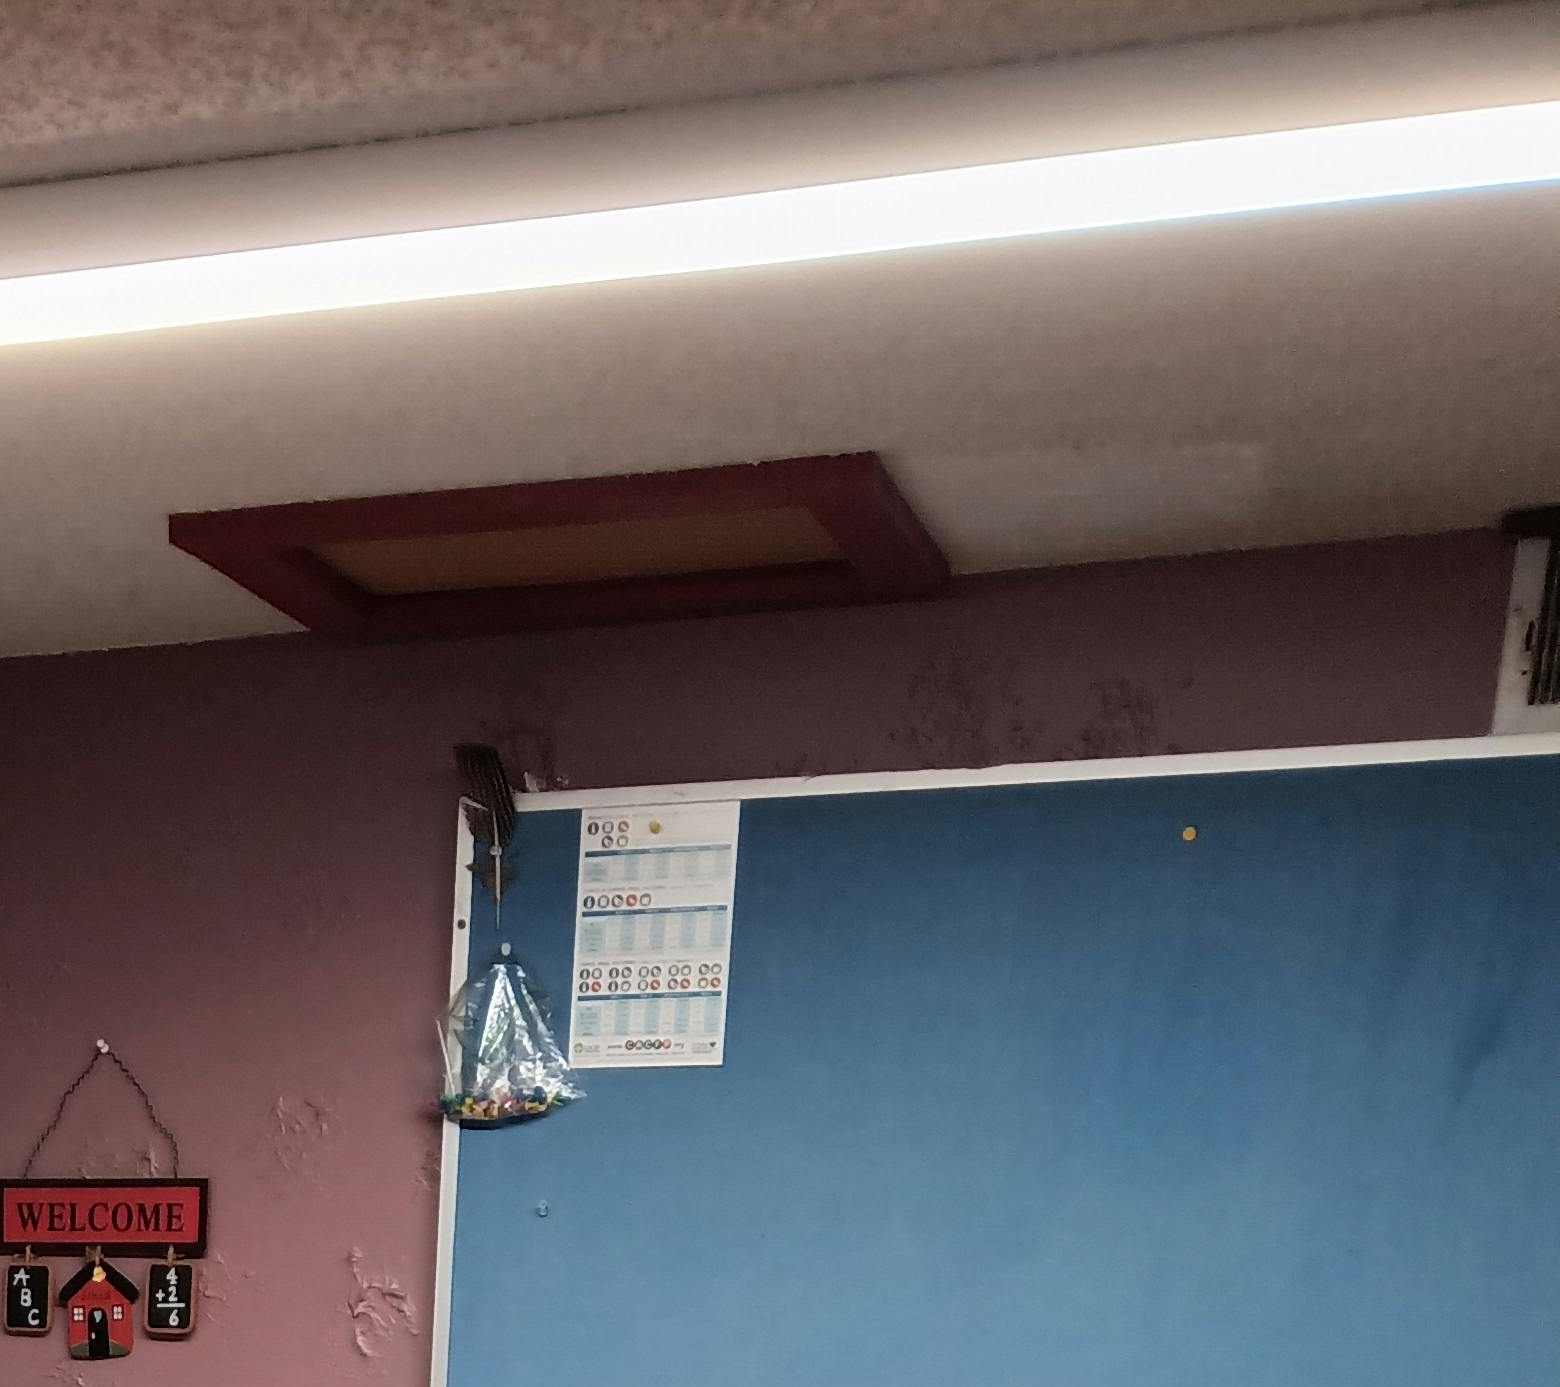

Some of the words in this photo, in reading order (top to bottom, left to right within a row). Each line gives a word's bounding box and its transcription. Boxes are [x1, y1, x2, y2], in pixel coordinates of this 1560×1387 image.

[16, 1202, 184, 1232] WELCOME
[13, 1268, 30, 1286] A
[166, 1267, 177, 1285] 4
[20, 1288, 32, 1307] B
[28, 1309, 39, 1326] C
[168, 1309, 180, 1327] 6
